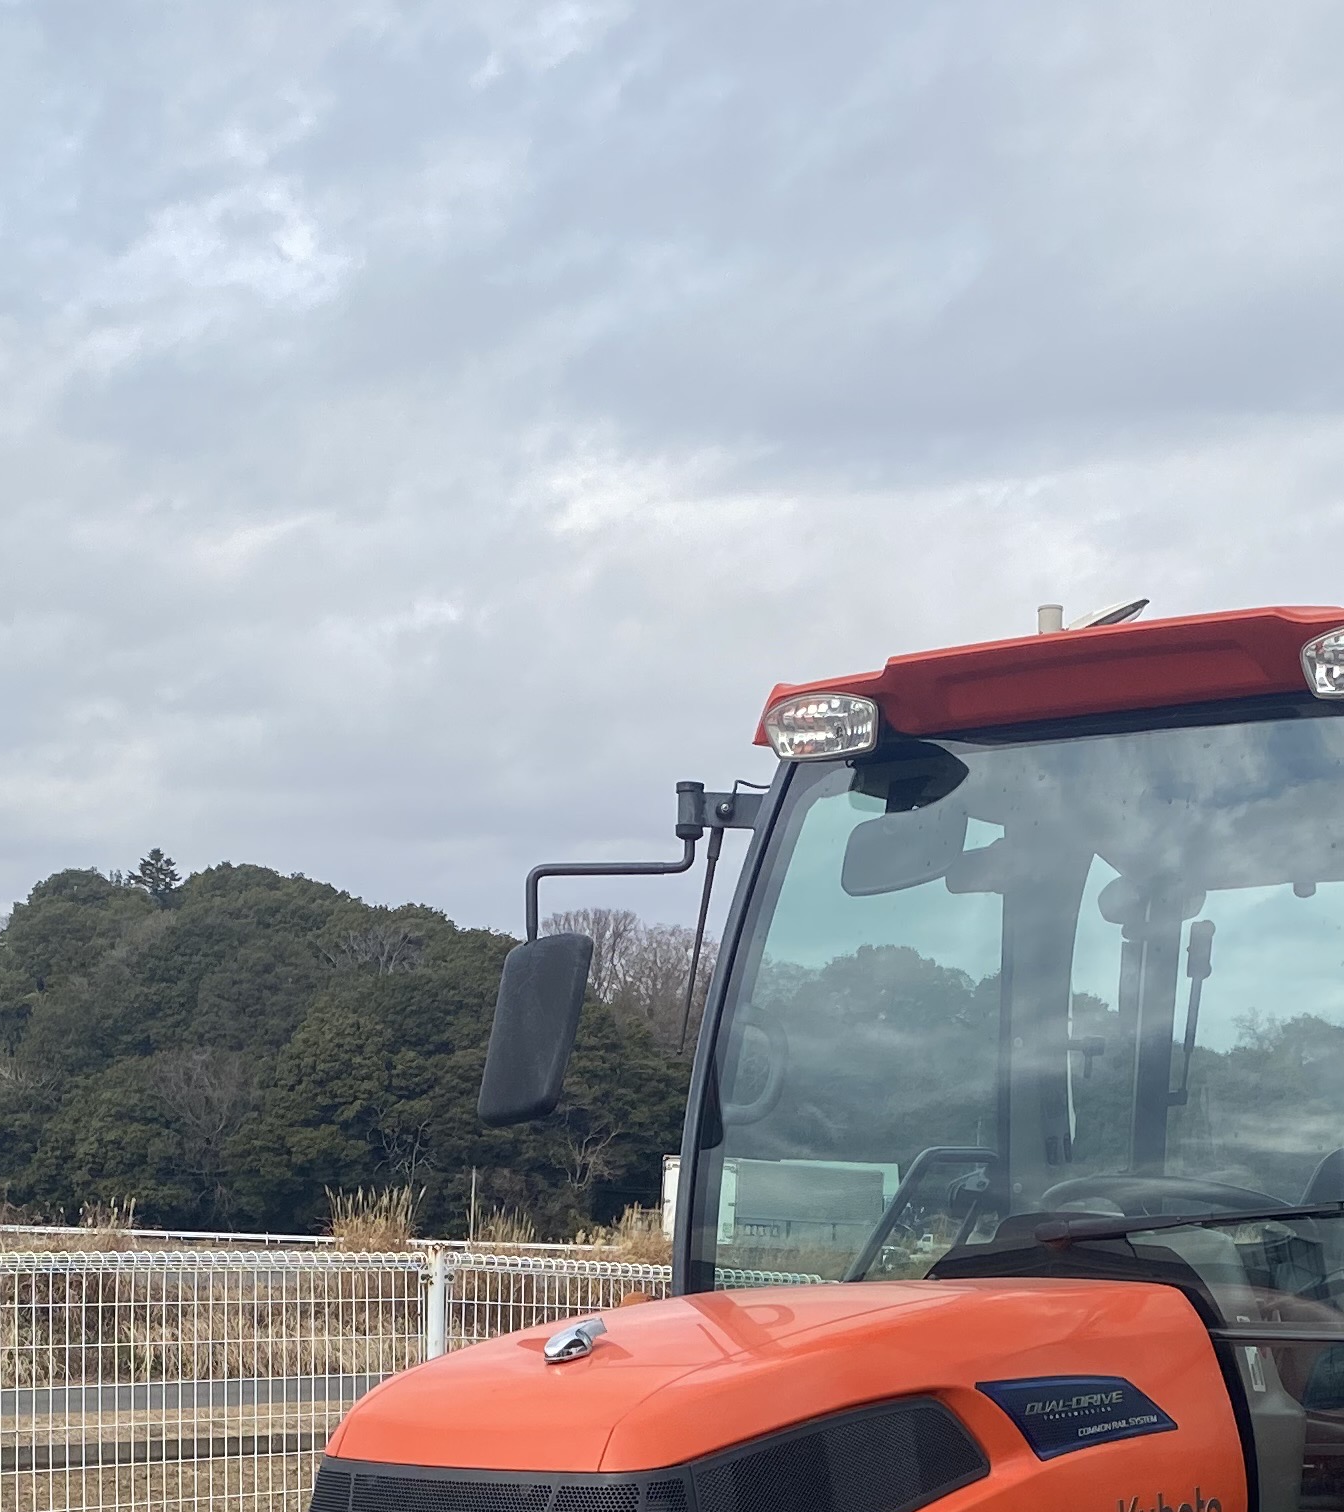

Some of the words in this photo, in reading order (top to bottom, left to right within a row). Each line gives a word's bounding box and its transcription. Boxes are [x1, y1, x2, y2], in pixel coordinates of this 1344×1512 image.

[1026, 1391, 1123, 1415] DUAL-DRIVE
[1079, 1423, 1112, 1437] COMMON
[1112, 1419, 1128, 1430] RAIL
[1129, 1415, 1158, 1426] SYSTEM
